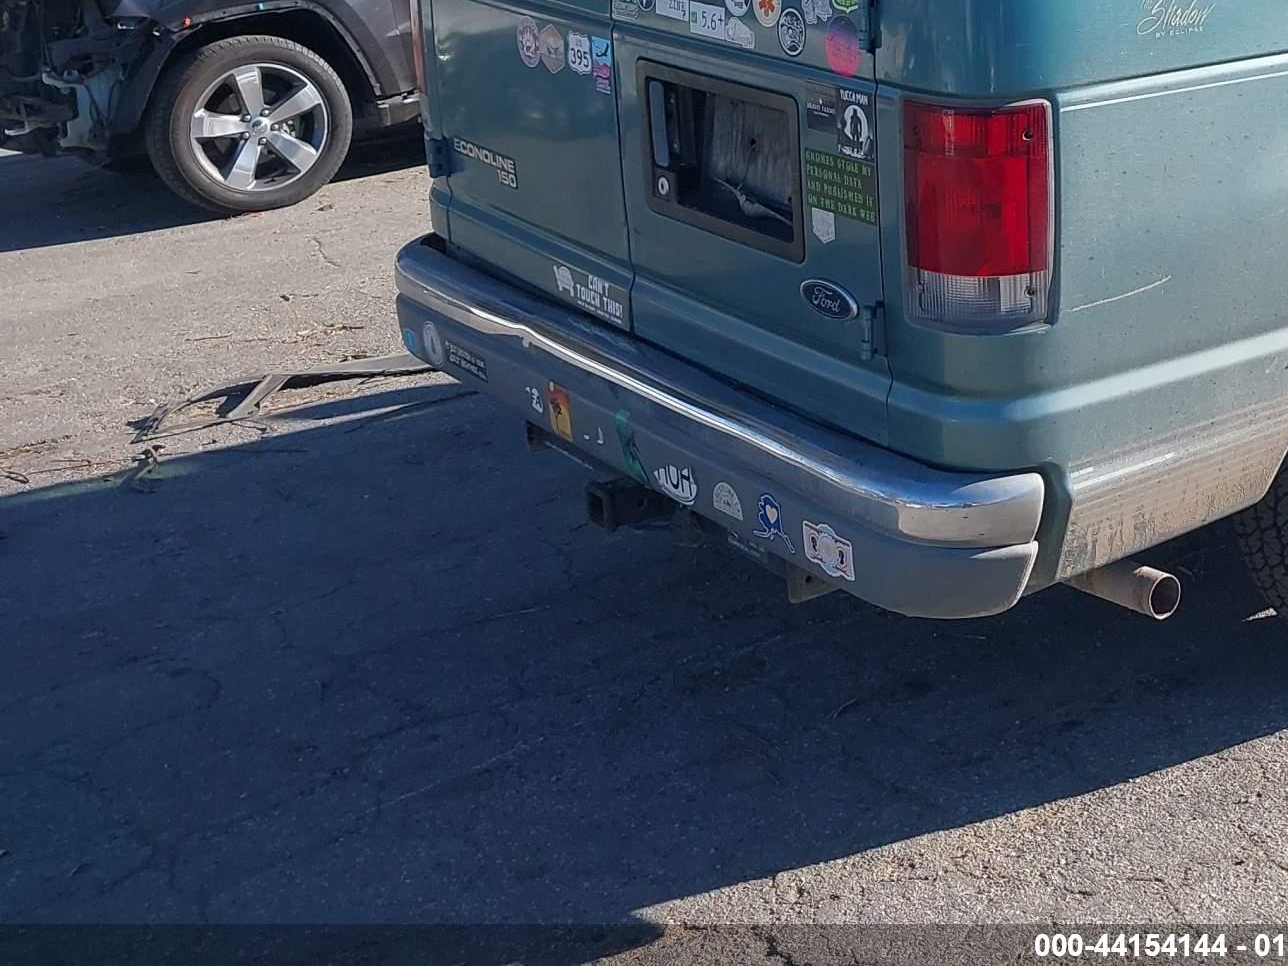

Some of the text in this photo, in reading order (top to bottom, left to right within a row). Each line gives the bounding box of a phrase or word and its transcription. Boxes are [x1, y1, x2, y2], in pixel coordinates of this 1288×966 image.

[1170, 27, 1203, 35] ECLIPSE
[570, 48, 589, 68] 395
[840, 89, 868, 106] YUCCA MAN
[454, 138, 515, 173] ECONOLINE
[806, 151, 871, 176] GNOMES STOLE MY
[497, 170, 516, 188] 150
[806, 164, 862, 189] PERSONAL DATA
[807, 180, 873, 206] AND PUBLISHED IT
[808, 195, 875, 222] ON THE DARK WEB
[588, 275, 609, 296] CAN'T
[576, 284, 600, 307] TOUCH
[603, 297, 623, 318] THIS!
[812, 287, 840, 312] Ford
